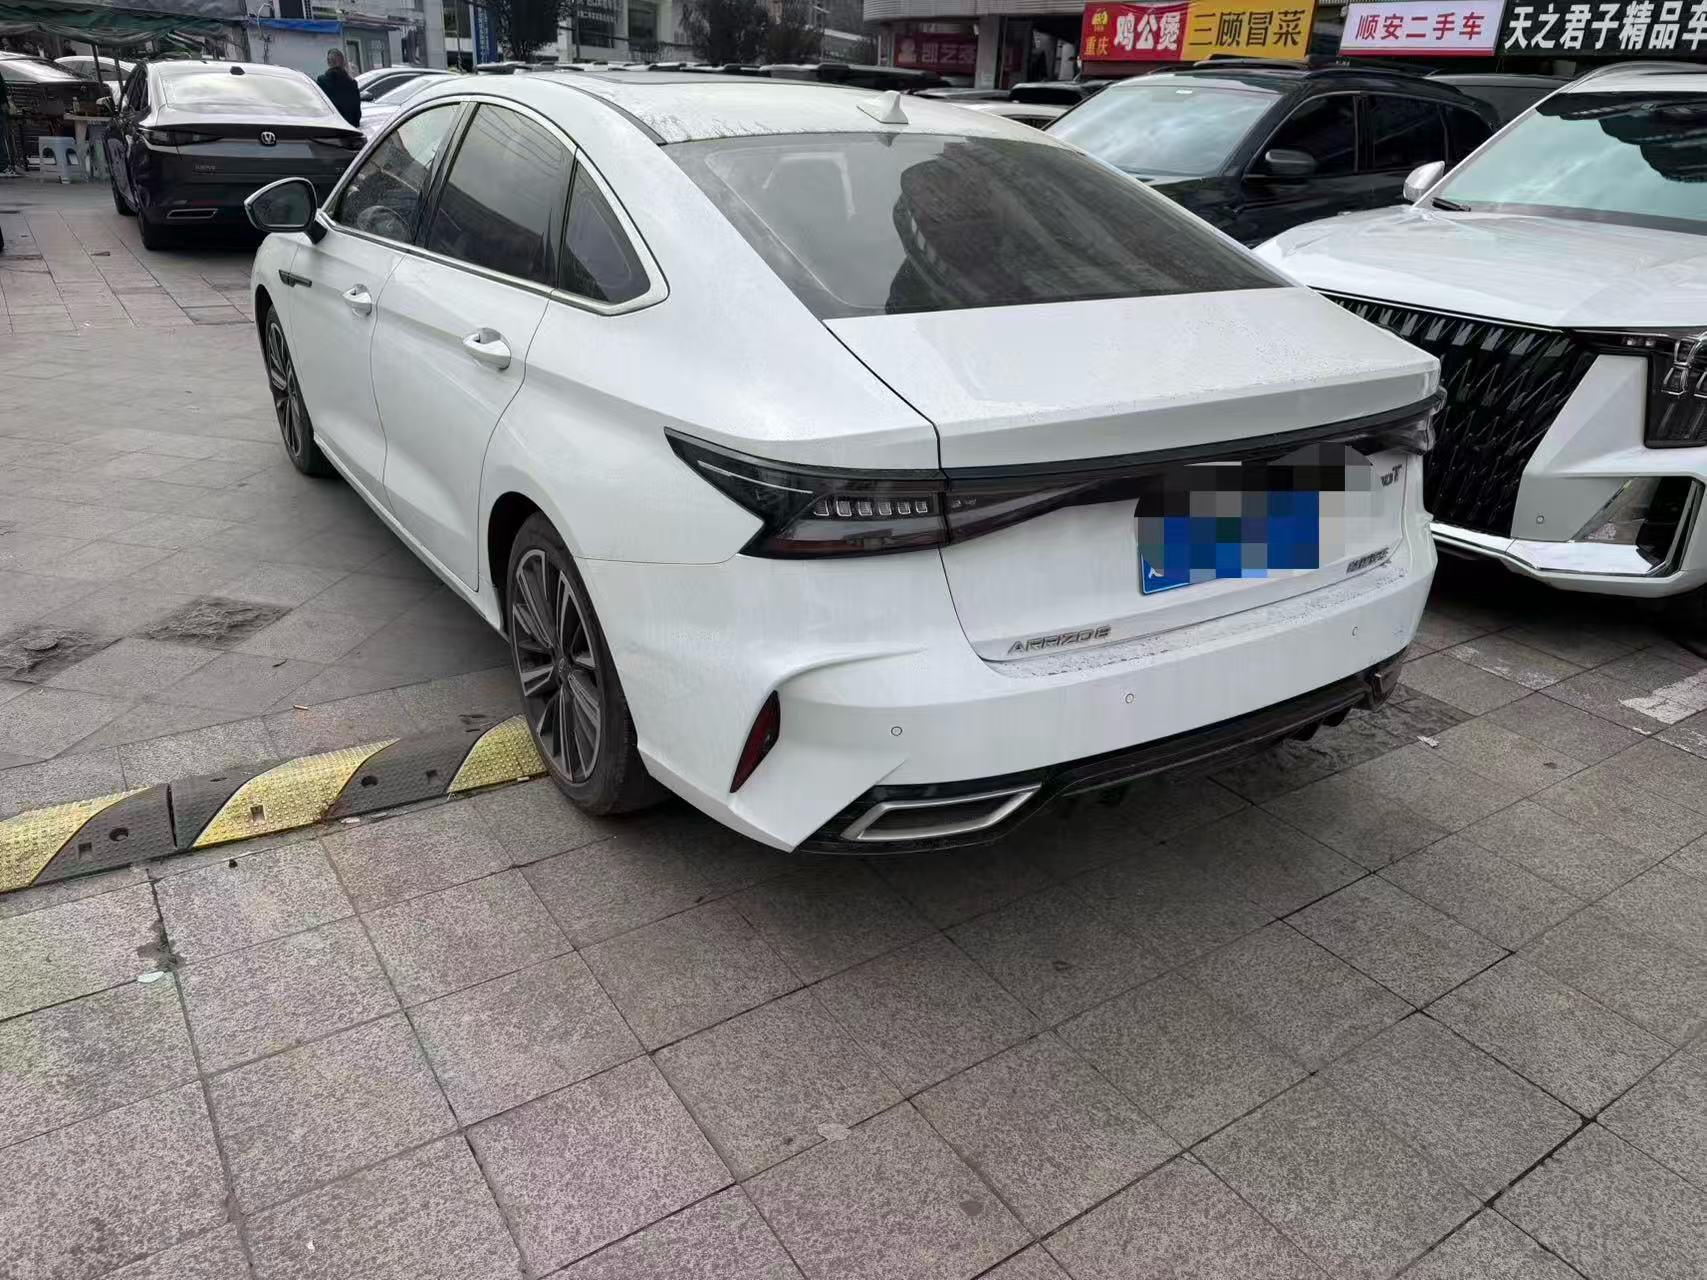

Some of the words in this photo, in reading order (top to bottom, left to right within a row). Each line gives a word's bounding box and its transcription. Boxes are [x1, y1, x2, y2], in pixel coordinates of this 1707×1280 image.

[1113, 12, 1181, 51] 鸡公煲
[1189, 9, 1305, 47] 三顾冒菜
[1355, 11, 1485, 40] 顺安二手车
[1504, 0, 1707, 50] 天之君子精品车
[1083, 36, 1109, 56] 重庆
